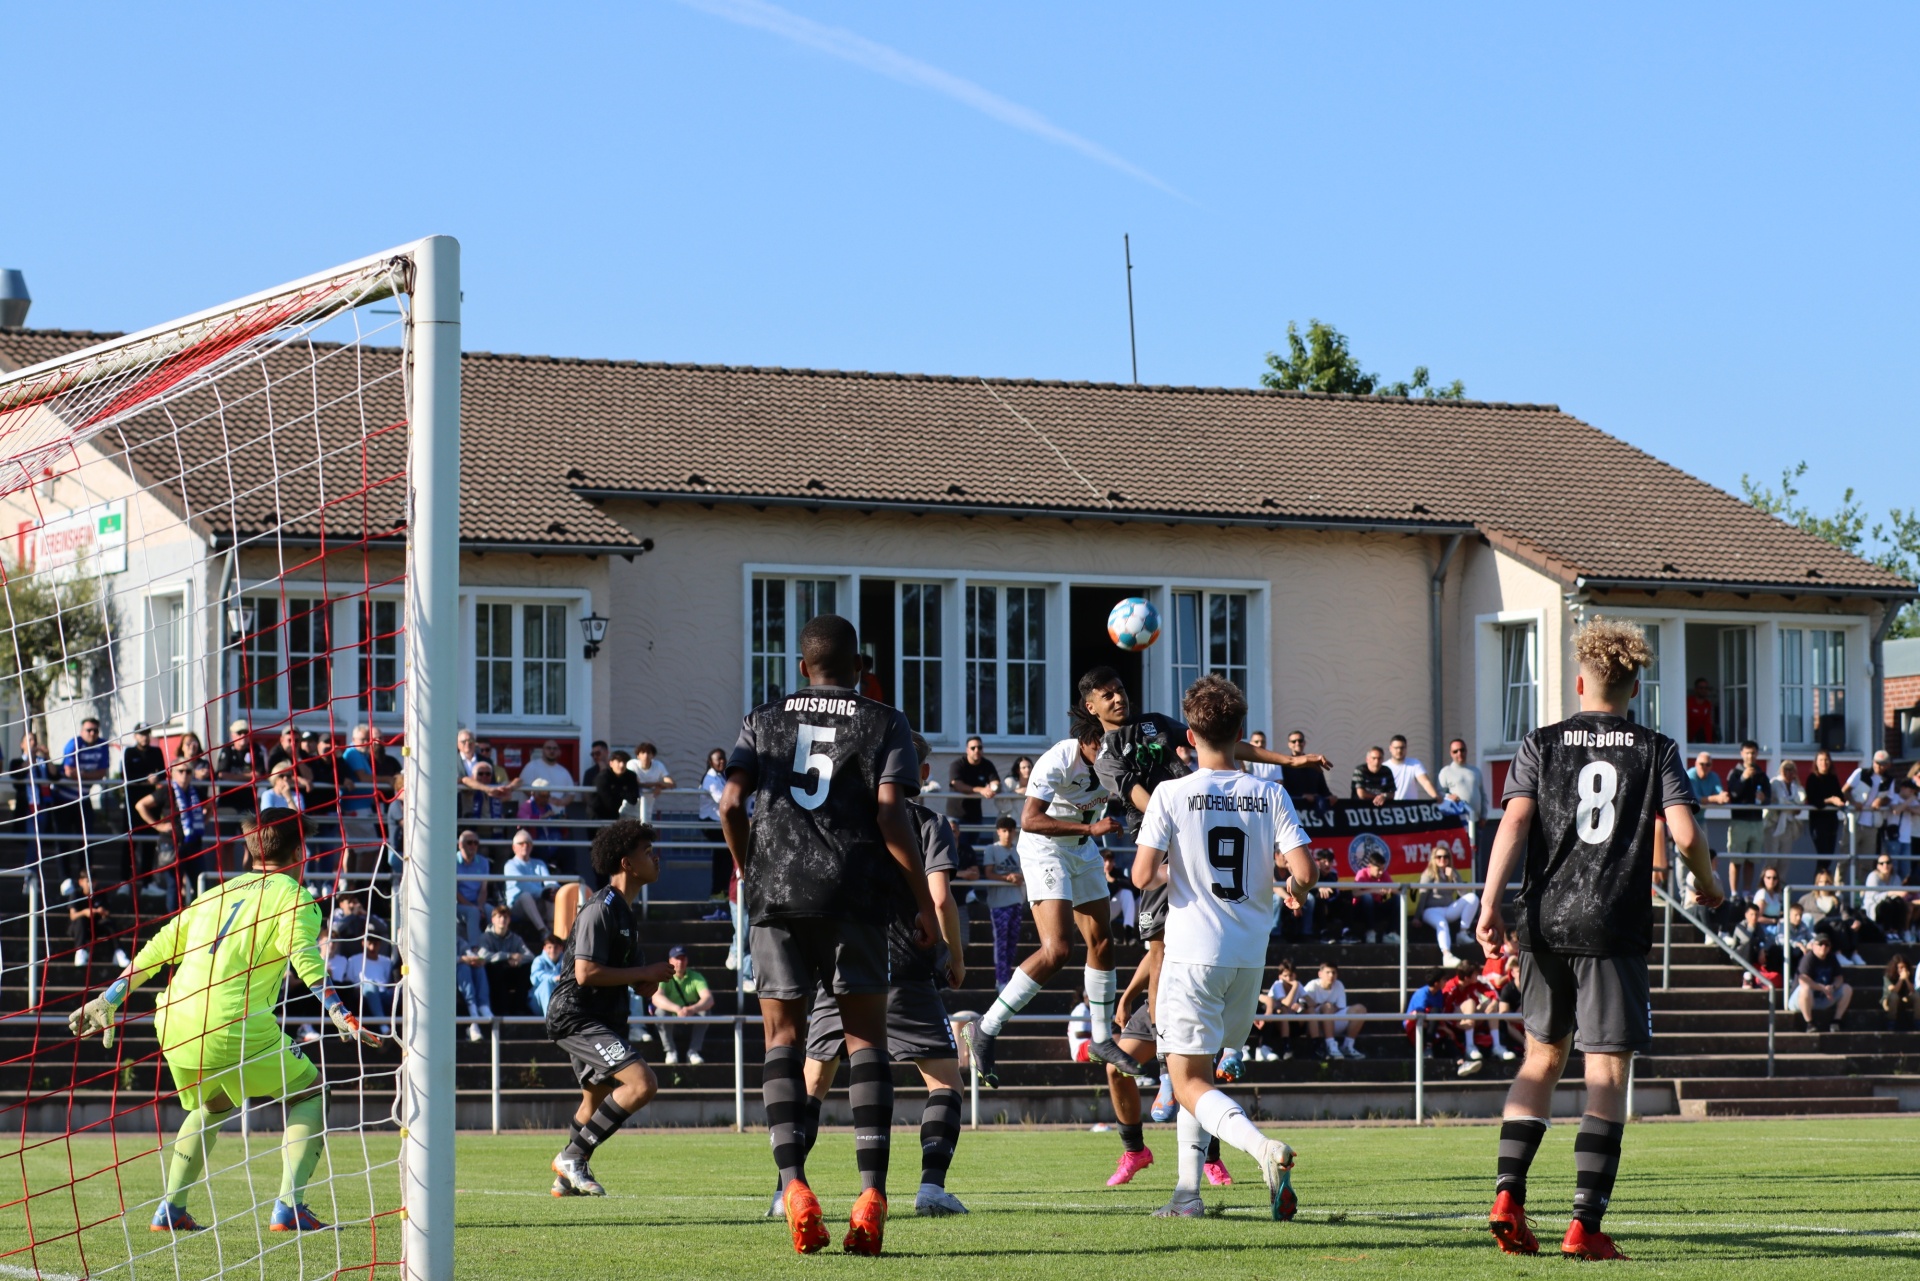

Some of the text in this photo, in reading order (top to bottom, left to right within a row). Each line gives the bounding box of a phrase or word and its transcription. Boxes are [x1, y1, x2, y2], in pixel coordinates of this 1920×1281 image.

[784, 697, 857, 716] DUISBURG
[1564, 730, 1634, 748] DUISBURG
[790, 723, 837, 811] 5
[1075, 795, 1109, 811] Santand
[1187, 792, 1268, 813] MÖNCHENGLADBACH
[1576, 760, 1618, 845] 8
[1296, 803, 1444, 828] MSV DUISBURG
[1208, 826, 1250, 904] 9
[208, 898, 246, 955] 1
